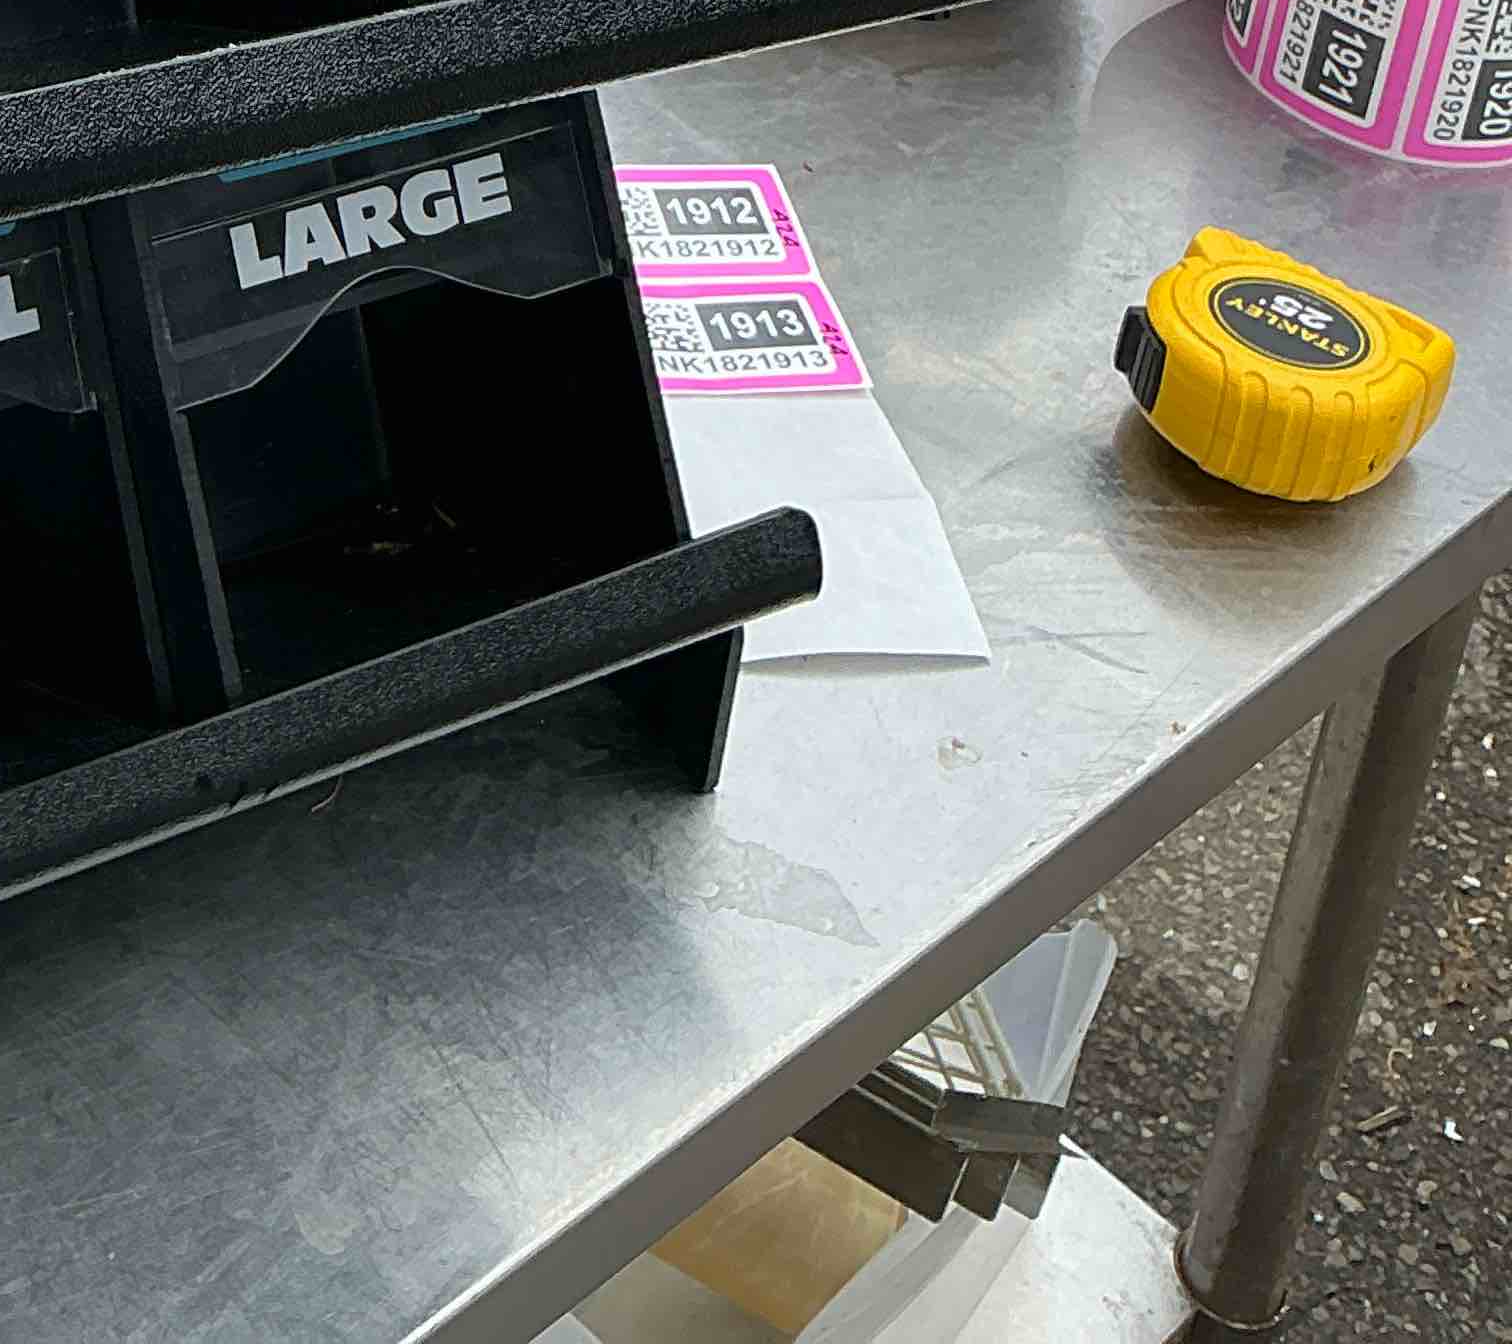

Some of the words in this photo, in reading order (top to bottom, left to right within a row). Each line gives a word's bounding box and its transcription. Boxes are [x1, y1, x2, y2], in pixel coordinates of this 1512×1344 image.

[1318, 28, 1369, 105] 1921
[228, 151, 514, 289] LARGE
[665, 195, 759, 226] 1912
[637, 238, 780, 260] K1821912
[709, 308, 806, 342] 1913
[1223, 296, 1351, 358] STANLEY
[656, 349, 829, 375] NK1821913
